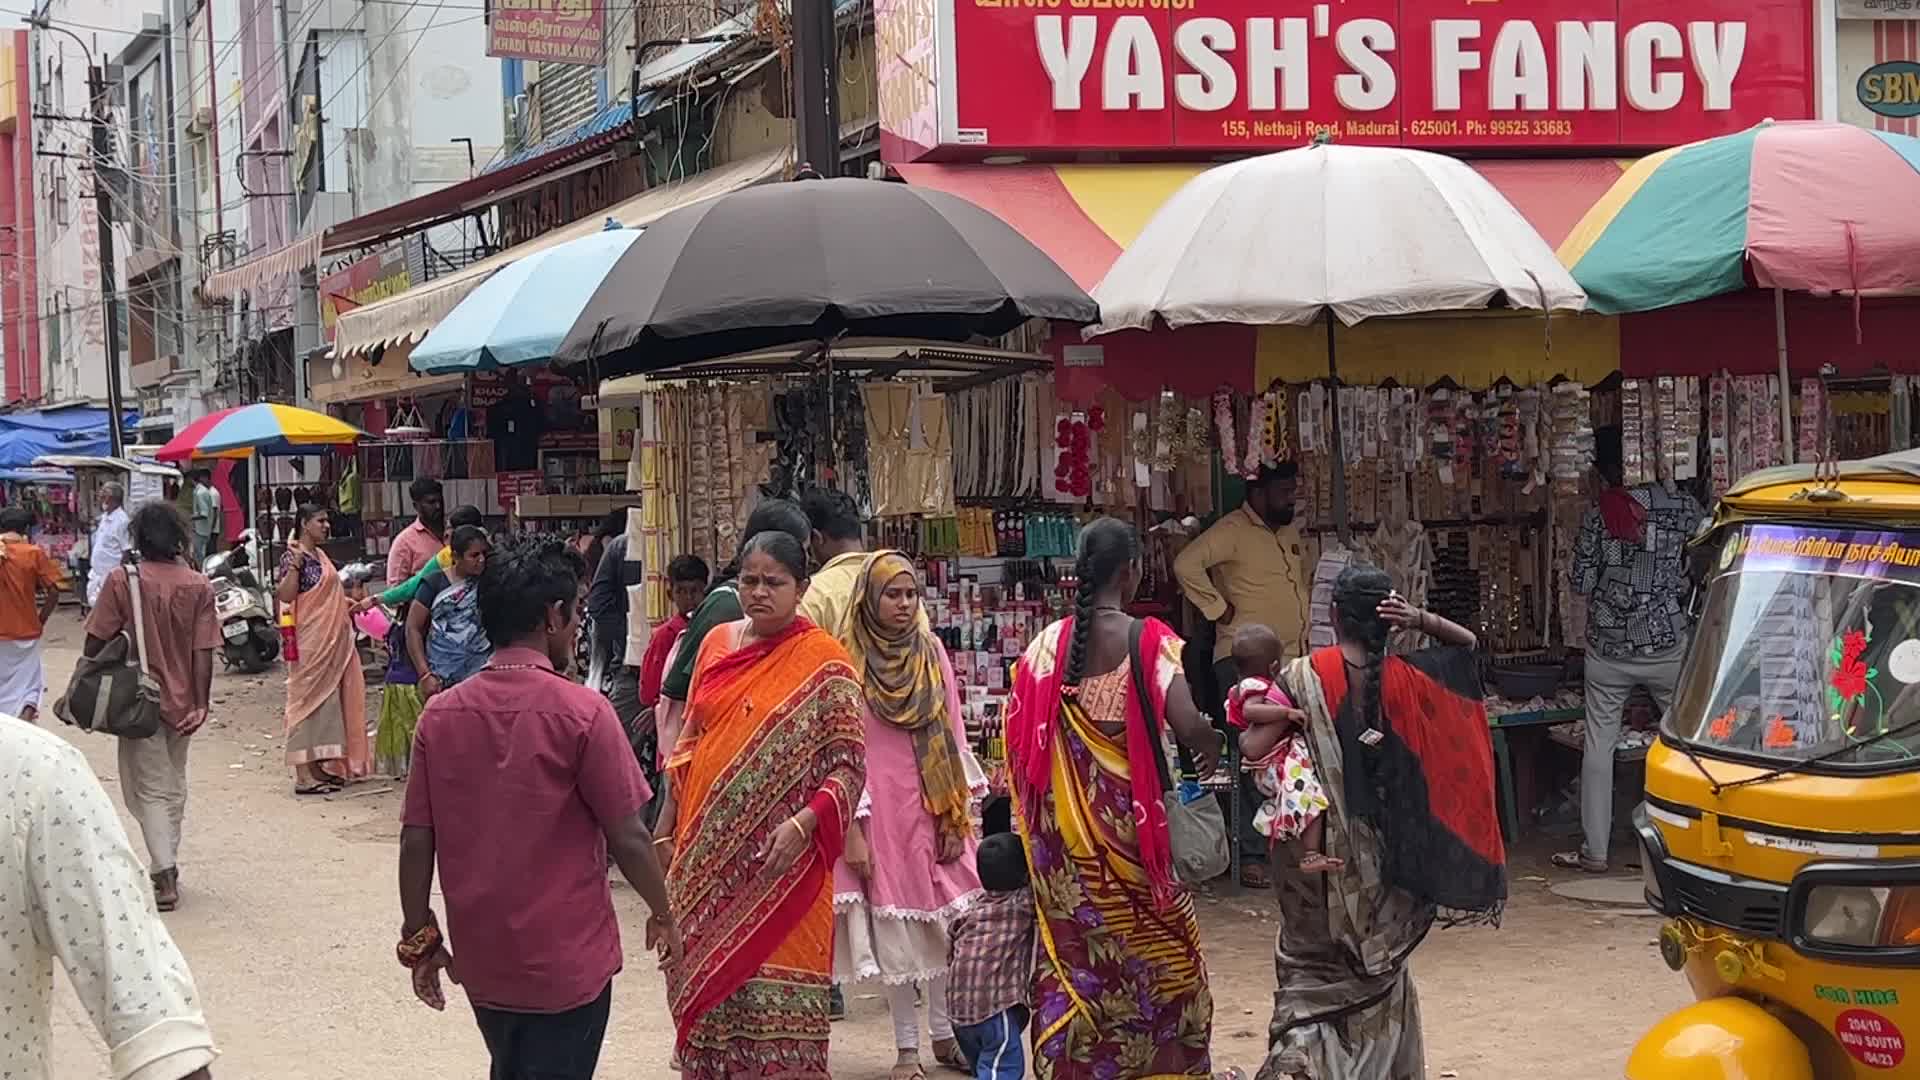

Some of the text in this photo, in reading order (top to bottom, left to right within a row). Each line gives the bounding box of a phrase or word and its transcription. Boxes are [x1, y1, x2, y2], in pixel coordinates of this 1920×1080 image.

[494, 37, 526, 52] KHADI
[1035, 5, 1747, 112] YASH'S FANCY
[1221, 120, 1250, 138] 155,
[1253, 120, 1302, 139] Nethaji
[1305, 120, 1343, 137] Road,
[1346, 119, 1399, 136] Madurai
[1411, 120, 1462, 136] 625001.
[1466, 120, 1487, 135] Ph:
[1490, 120, 1529, 135] 99525
[1533, 120, 1572, 136] 33683
[1854, 989, 1899, 1004] HIRE
[1840, 1031, 1902, 1049] MDU SOUTH
